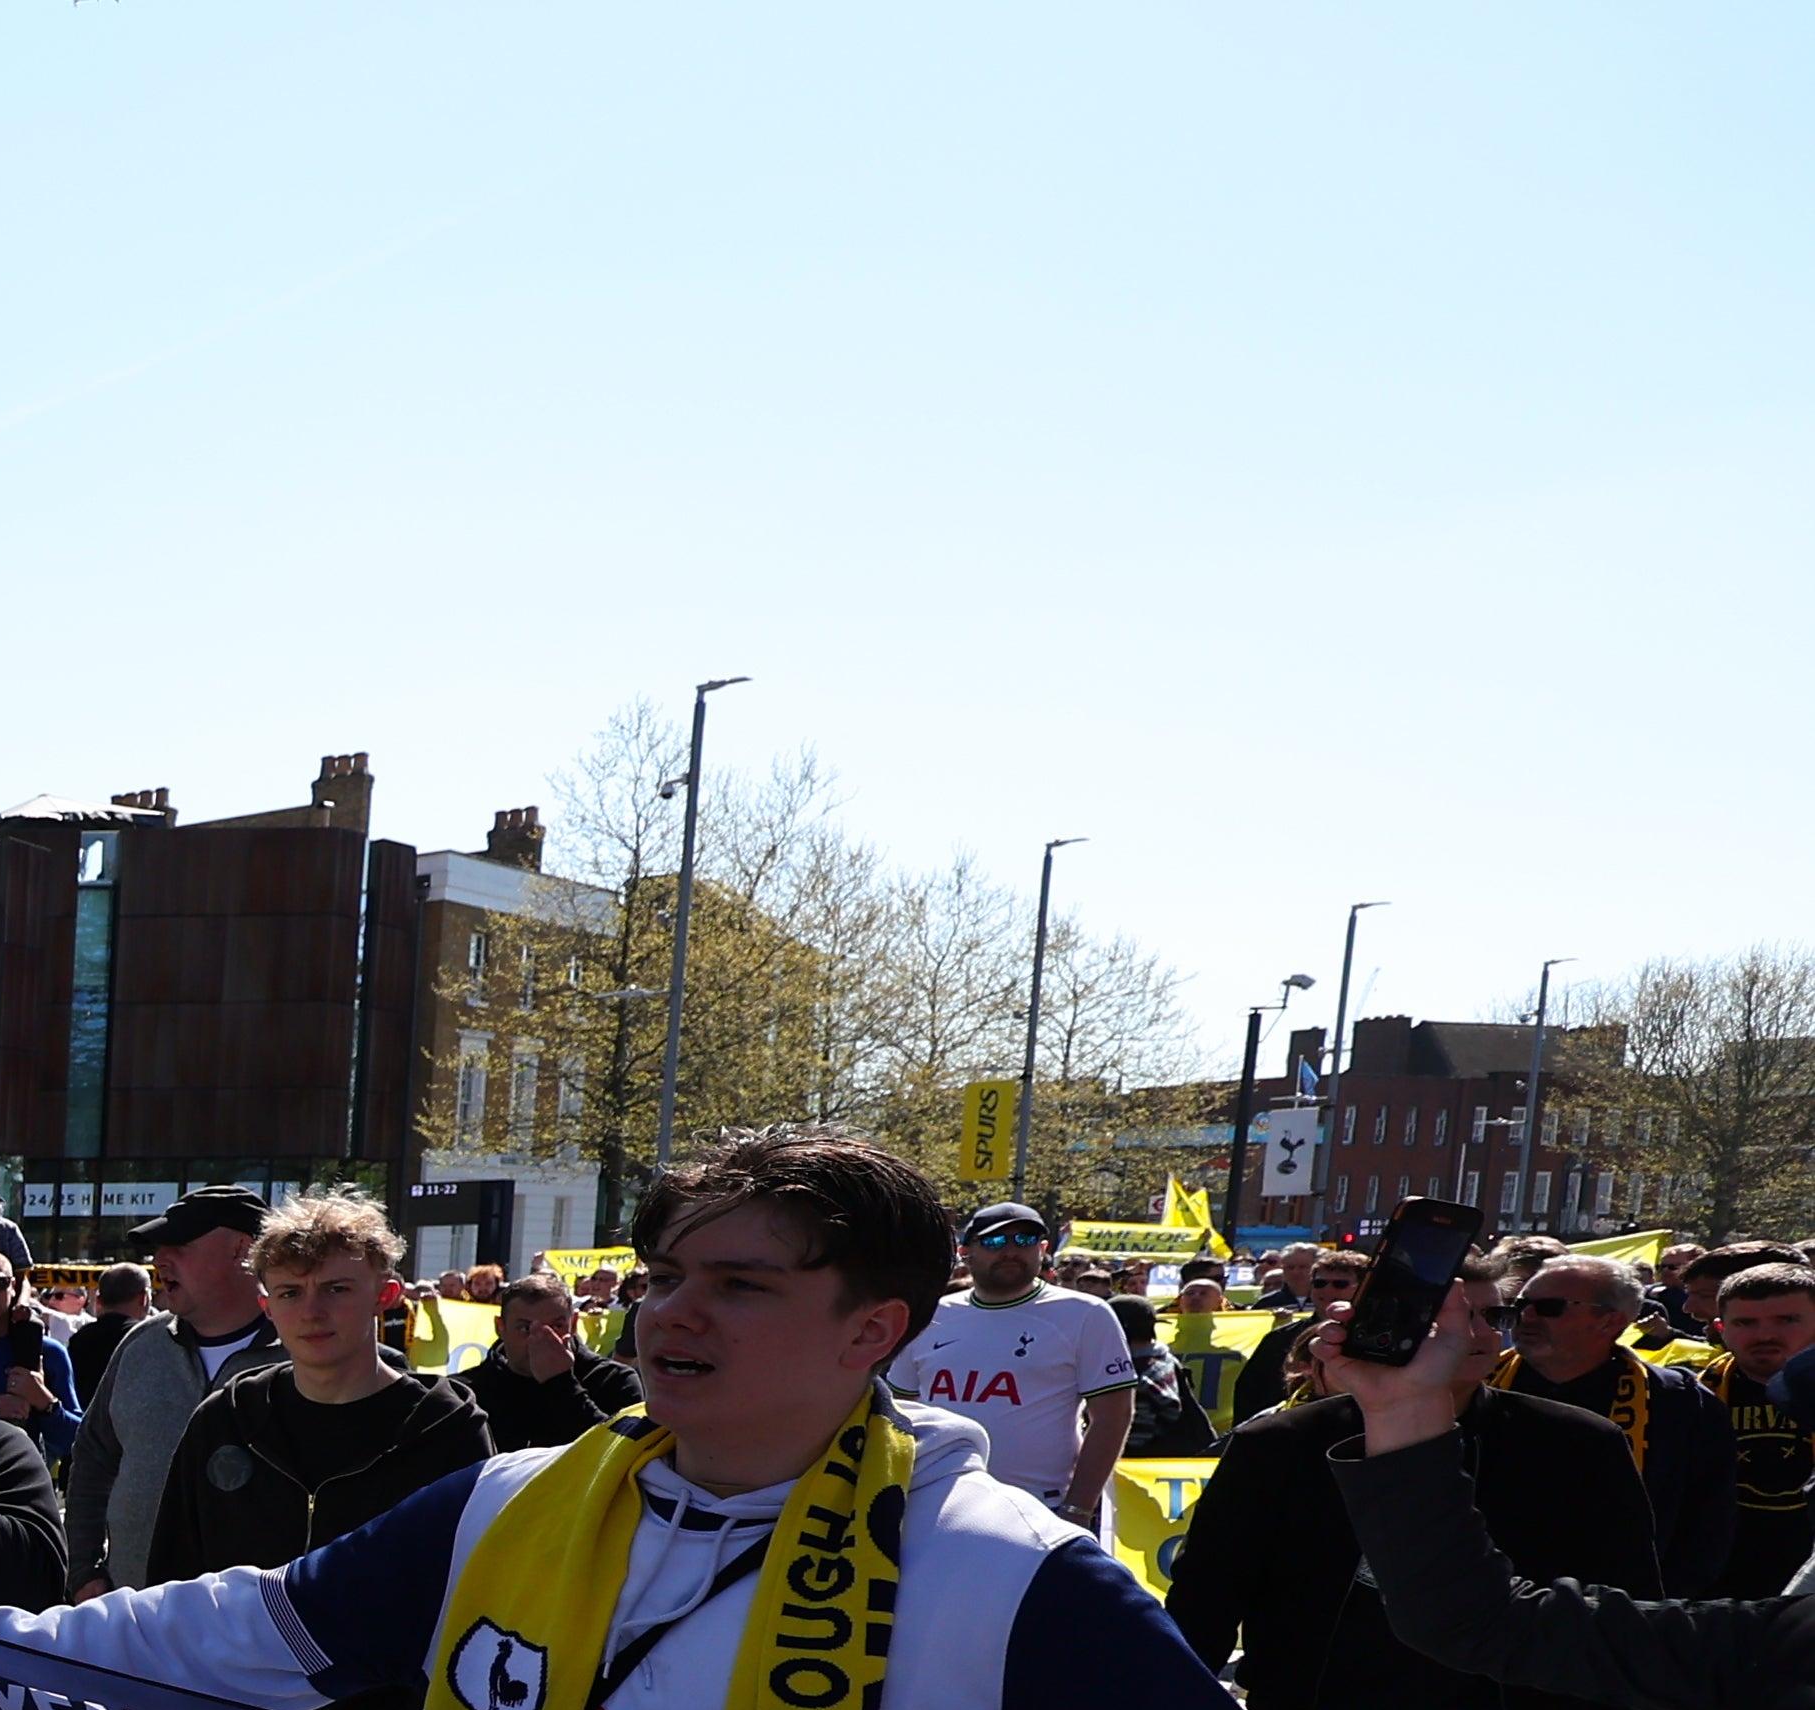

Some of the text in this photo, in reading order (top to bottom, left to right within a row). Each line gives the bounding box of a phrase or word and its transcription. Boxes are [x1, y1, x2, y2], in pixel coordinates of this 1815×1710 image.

[974, 1088, 999, 1172] SPURS
[81, 1193, 125, 1206] HME
[131, 1193, 156, 1206] KIT
[928, 1369, 1022, 1406] AIA
[1731, 1403, 1798, 1430] IRVA
